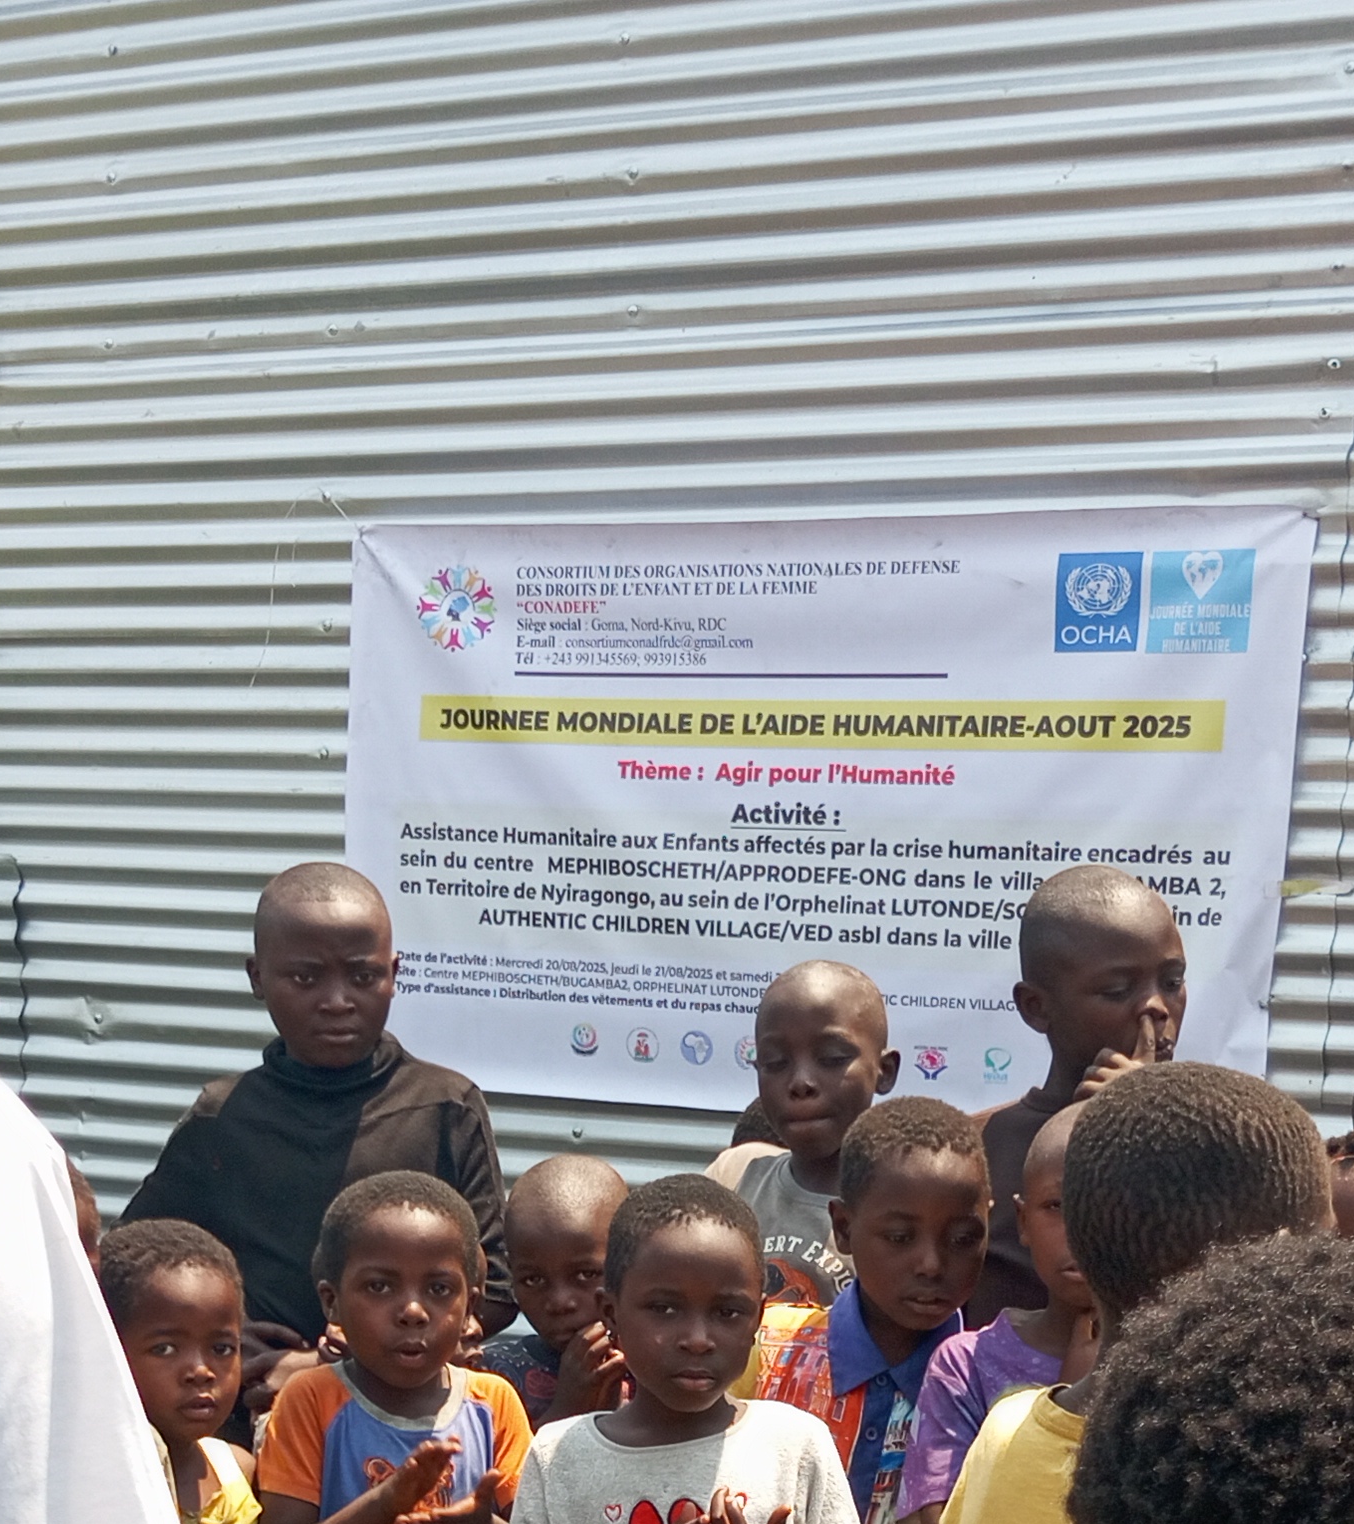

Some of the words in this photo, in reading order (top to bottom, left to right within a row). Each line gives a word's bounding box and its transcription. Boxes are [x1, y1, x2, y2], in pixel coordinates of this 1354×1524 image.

[516, 565, 610, 580] CONSORTIUM
[614, 565, 640, 579] DES
[644, 563, 763, 579] ORGANISATIONS
[766, 562, 862, 577] NATIONALES
[866, 561, 886, 576] DE
[890, 560, 960, 575] DEFENSE
[516, 584, 542, 597] DES
[545, 583, 596, 597] DROITS
[600, 583, 619, 596] DE
[694, 582, 713, 595] ET
[716, 582, 736, 595] DE
[739, 582, 758, 595] LA
[762, 581, 818, 595] FEMME
[1150, 602, 1193, 619] JOURNÉE
[1197, 604, 1251, 618] MONDIALE
[517, 618, 546, 636] Siège
[549, 618, 581, 632] social
[592, 618, 628, 633] Goma,
[631, 618, 695, 633] Nord-Kivu,
[698, 618, 727, 631] RDC
[1061, 625, 1132, 645] OCHA
[1174, 621, 1188, 636] DE
[517, 635, 555, 648] E-mail
[1162, 638, 1231, 652] HUMANITAIRE
[515, 652, 534, 665] Tél
[545, 653, 572, 665] +243
[644, 653, 707, 667] 993915386
[440, 709, 550, 731] JOURNEE
[555, 711, 693, 734] MONDIALE
[700, 713, 735, 735] DE
[832, 714, 1116, 739] HUMANITAIRE-AOUT
[1123, 715, 1191, 738] 2025
[618, 760, 691, 781] Thème
[715, 762, 763, 786] Agir
[769, 766, 822, 787] pour
[731, 802, 827, 826] Activité
[400, 822, 498, 843] Assistance
[503, 827, 617, 848] Humanitaire
[621, 834, 657, 850] aux
[662, 833, 739, 852] Enfants
[744, 836, 826, 854] affectés
[831, 842, 865, 860] par
[869, 838, 887, 857] la
[893, 838, 943, 858] crise
[948, 840, 1082, 862] humanitaire
[1087, 844, 1192, 865] encadrés
[1203, 850, 1230, 865] au
[400, 849, 436, 867] sein
[443, 851, 466, 869] du
[474, 854, 534, 872] centre
[548, 857, 906, 886] MEPHIBOSCHETH/APPRODEFE-ONG
[914, 869, 965, 888] dans
[974, 871, 992, 889] le
[1001, 871, 1044, 891] villa
[1209, 878, 1226, 899] 2,
[400, 880, 421, 894] en
[426, 878, 509, 899] Territoire
[514, 882, 536, 900] de
[541, 883, 655, 909] Nyiragongo,
[659, 892, 683, 907] au
[687, 890, 729, 909] sein
[734, 892, 759, 910] de
[1197, 907, 1222, 926] de
[478, 909, 586, 930] AUTHENTIC
[592, 915, 689, 935] CHILDREN
[696, 919, 832, 942] VILLAGE/VED
[838, 925, 880, 944] asbl
[887, 927, 937, 946] dans
[944, 929, 961, 947] la
[968, 929, 1012, 949] ville
[396, 951, 421, 962] Date
[424, 952, 437, 963] de
[496, 957, 543, 970] Mercredi
[642, 965, 651, 976] le
[655, 966, 712, 980] 21/08/2025
[715, 970, 727, 981] et
[730, 971, 773, 983] samedi
[395, 981, 421, 994] Type
[499, 988, 566, 1002] Distribution
[569, 991, 589, 1003] des
[592, 994, 653, 1008] vêtements
[656, 998, 668, 1009] et
[671, 999, 686, 1010] du
[690, 1002, 721, 1014] repas
[424, 968, 459, 980] Centre
[633, 980, 707, 995] ORPHELINAT
[901, 995, 966, 1009] CHILDREN
[969, 998, 1020, 1011] VILLAG
